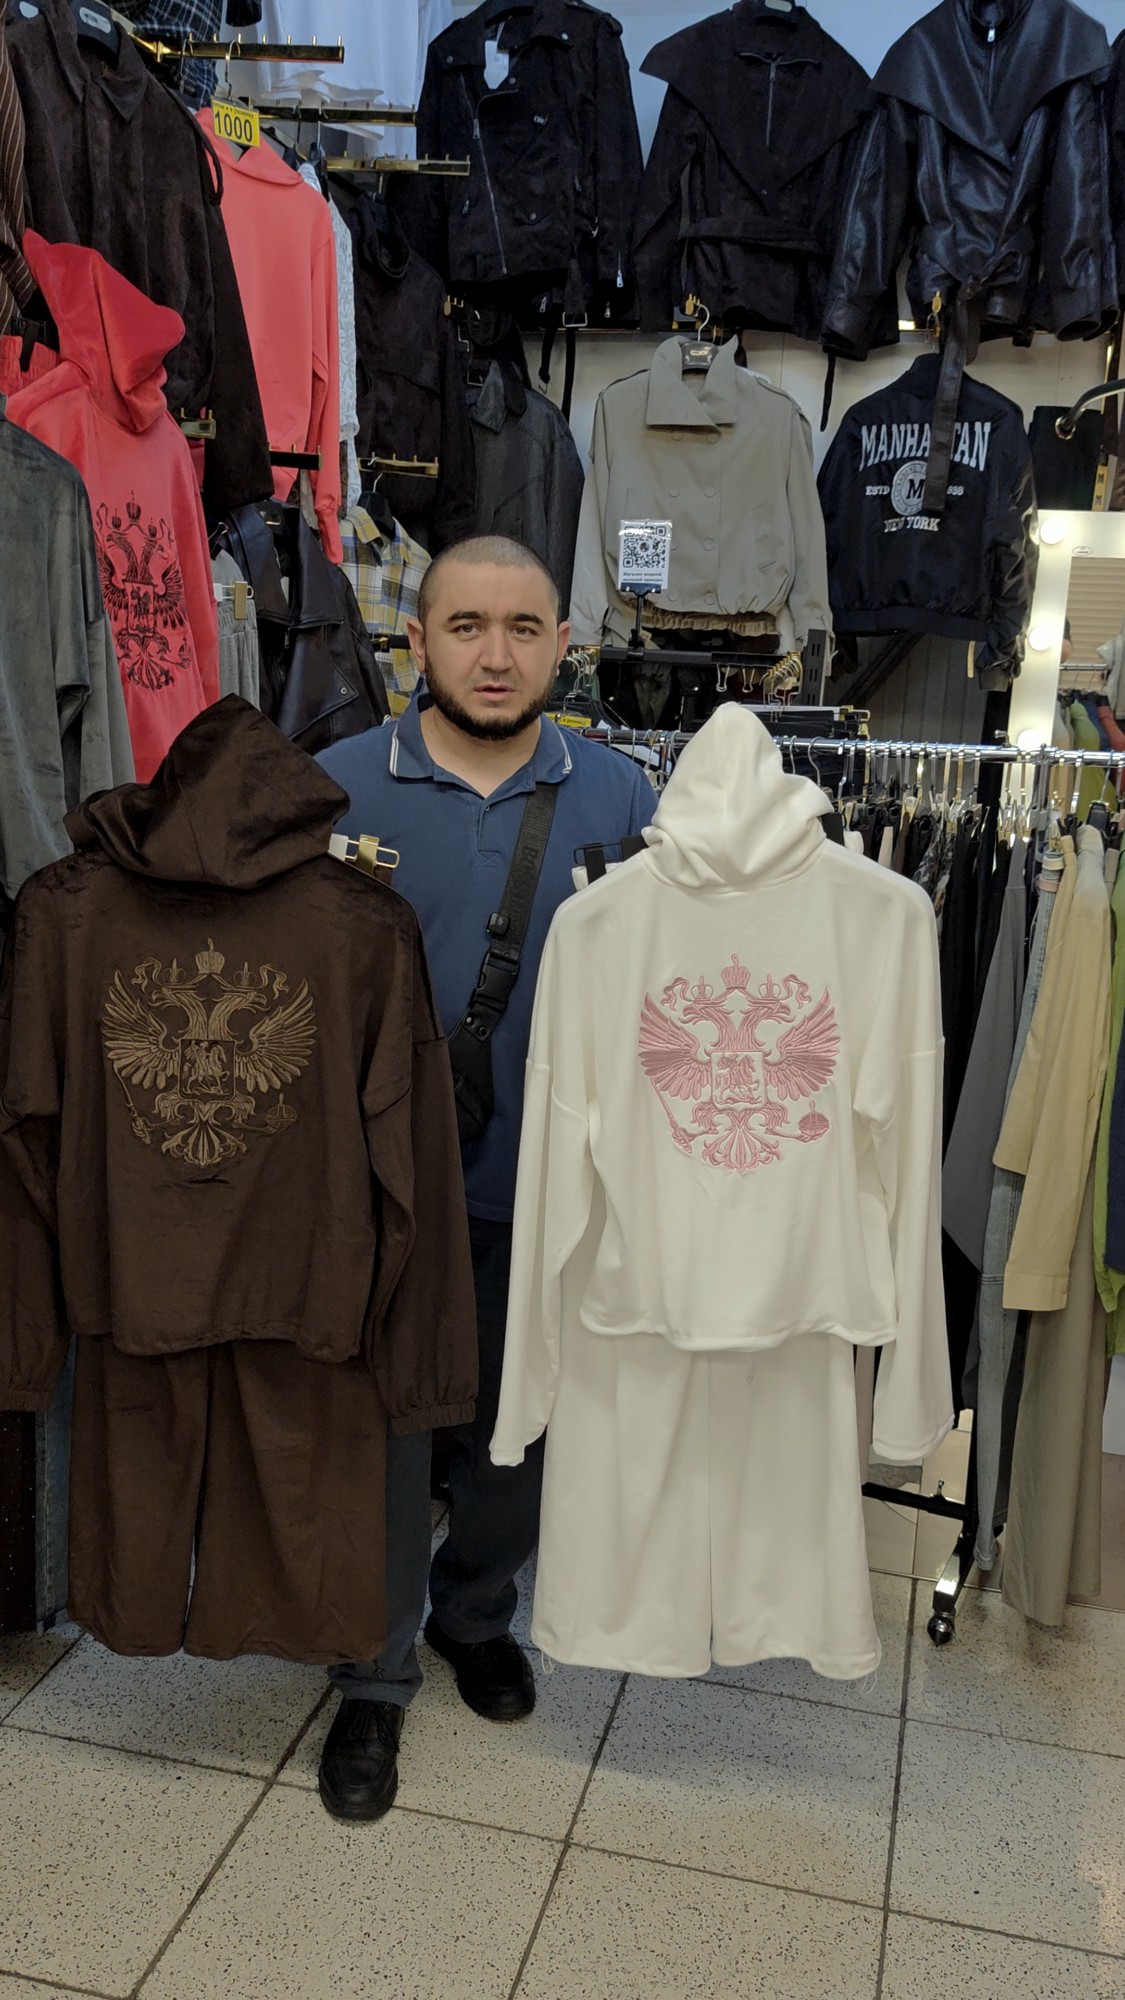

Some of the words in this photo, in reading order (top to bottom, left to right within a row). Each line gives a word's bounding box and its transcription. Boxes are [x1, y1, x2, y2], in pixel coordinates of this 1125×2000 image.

[215, 110, 253, 142] 1000
[859, 421, 992, 472] MANHATAN
[865, 485, 890, 495] ESTD
[905, 478, 926, 500] M
[883, 517, 905, 533] NEW
[906, 515, 941, 532] YORK
